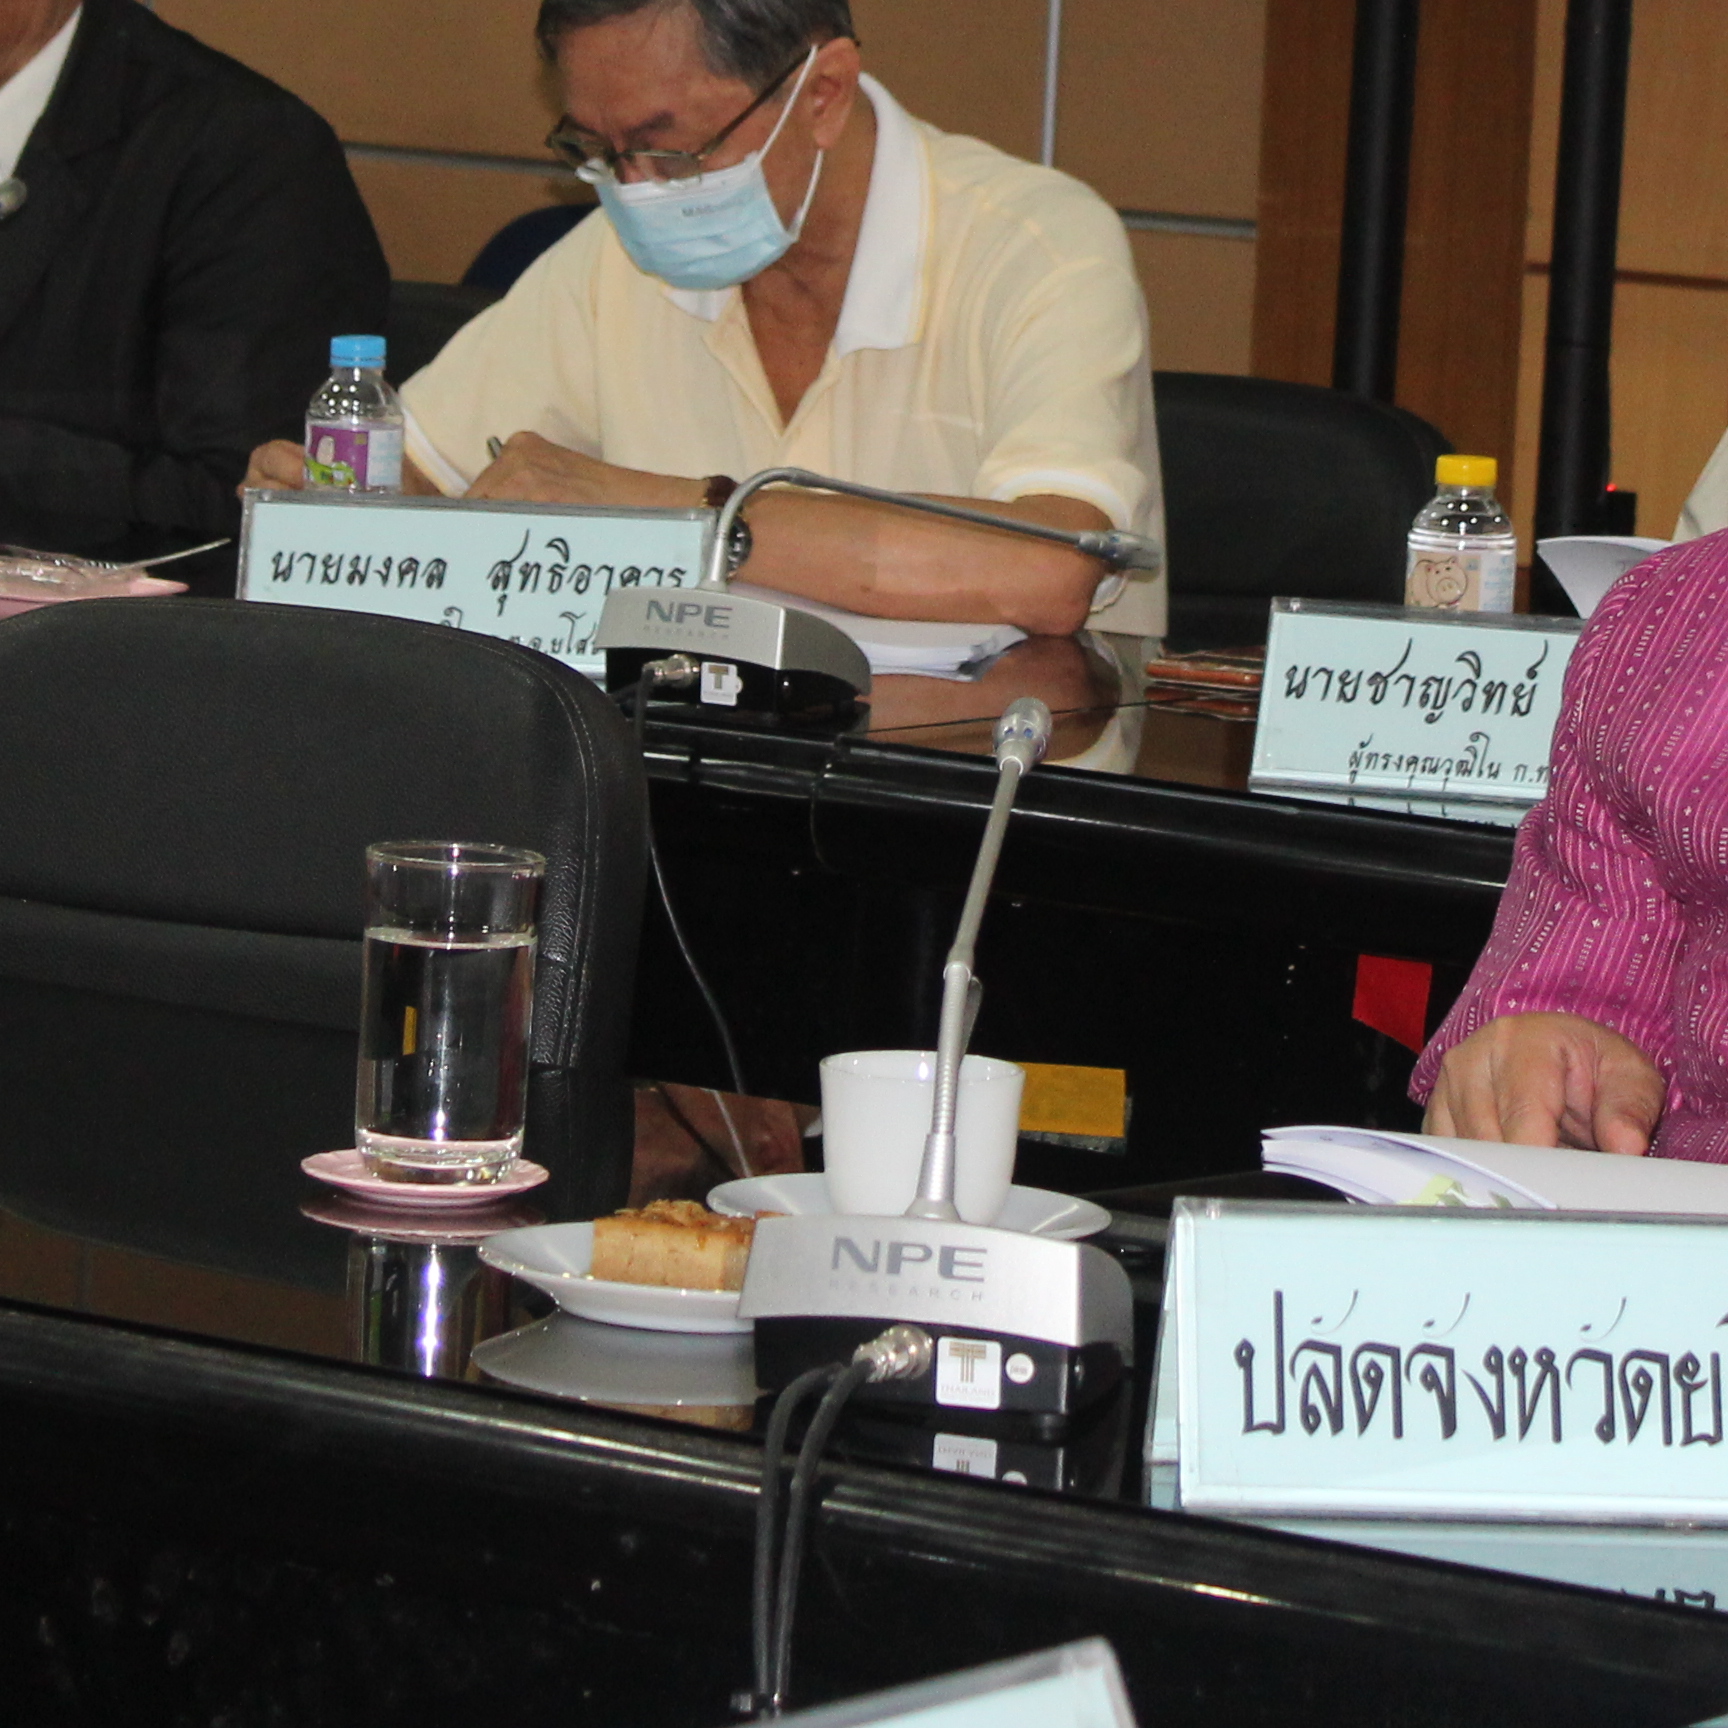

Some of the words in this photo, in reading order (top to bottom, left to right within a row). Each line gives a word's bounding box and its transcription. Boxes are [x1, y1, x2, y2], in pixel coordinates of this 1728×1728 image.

[271, 548, 448, 590] นายมงคล
[646, 600, 733, 629] NPE
[1284, 636, 1549, 725] นายชาญวิทย์
[831, 1236, 987, 1283] NPE
